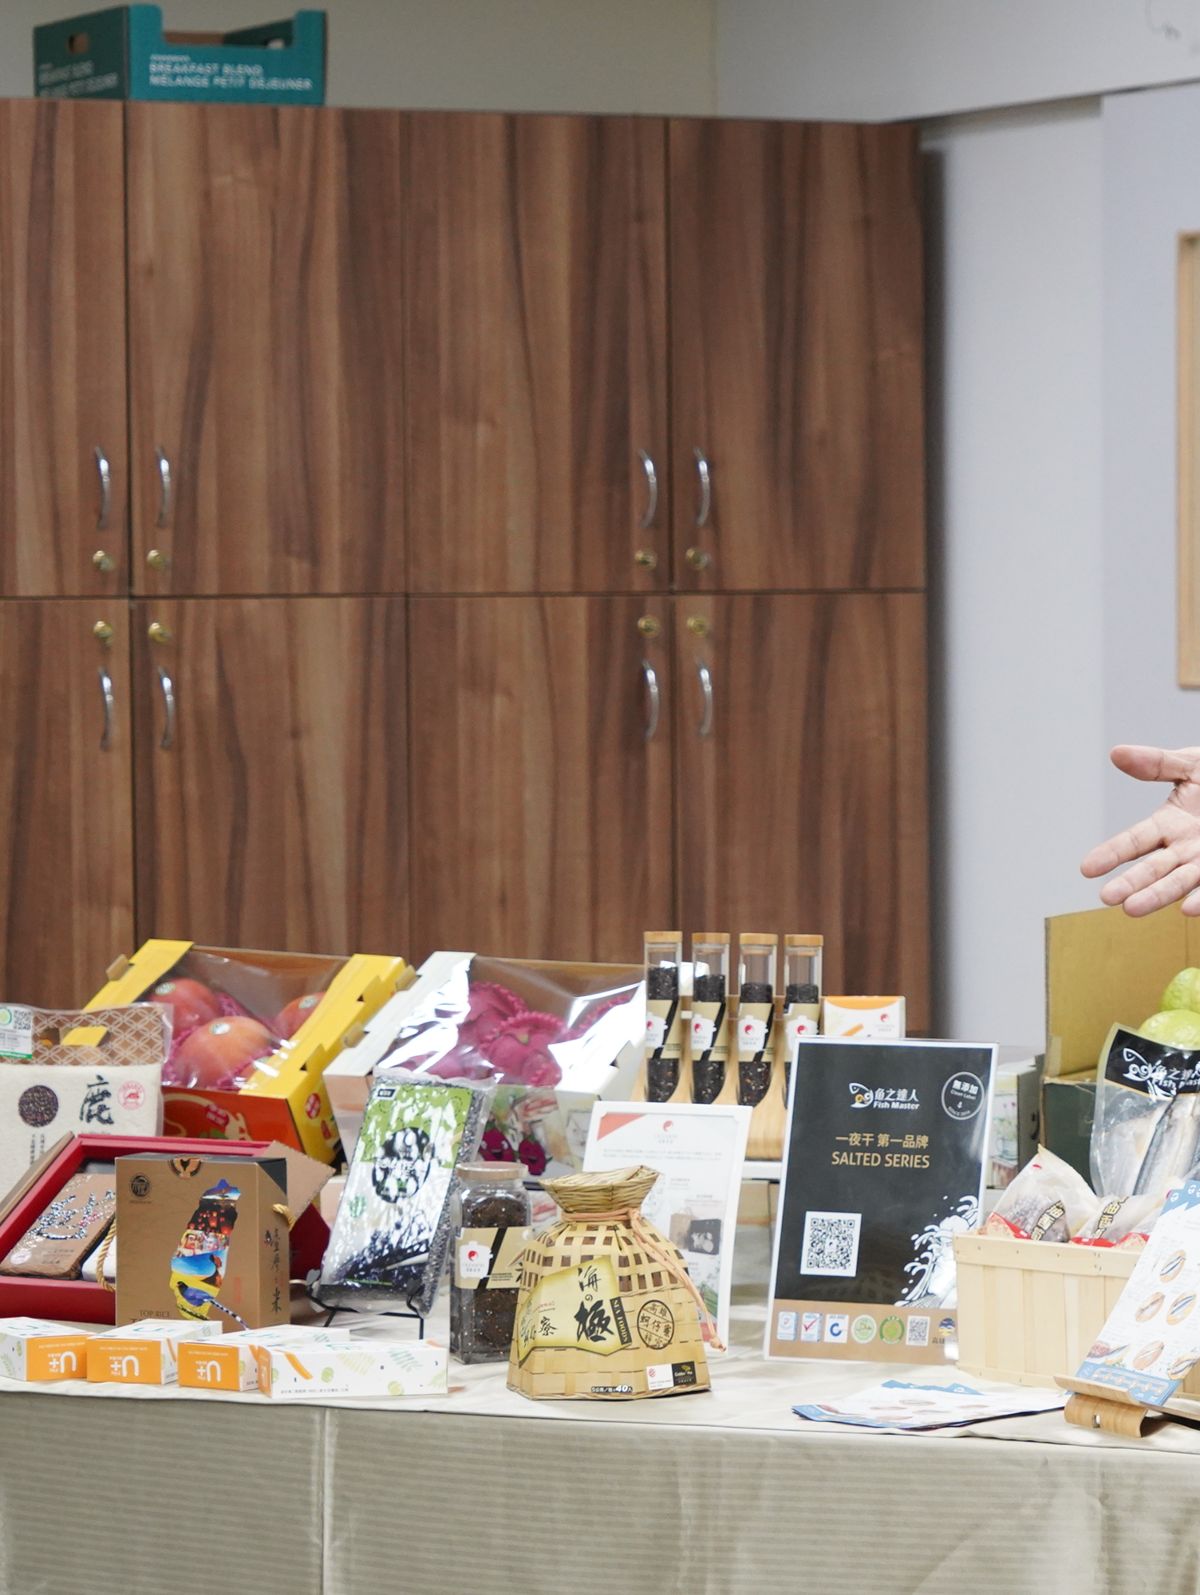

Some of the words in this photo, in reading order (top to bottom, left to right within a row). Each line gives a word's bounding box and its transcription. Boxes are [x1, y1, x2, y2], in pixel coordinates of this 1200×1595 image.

[874, 1087, 919, 1102] 魚之達人
[873, 1100, 890, 1109] Fish
[891, 1102, 920, 1110] Master
[835, 1132, 875, 1148] 一夜干
[877, 1133, 929, 1149] 第一品牌
[832, 1151, 881, 1167] SALTED
[884, 1153, 931, 1169] SERIES
[617, 1316, 629, 1343] FOODS
